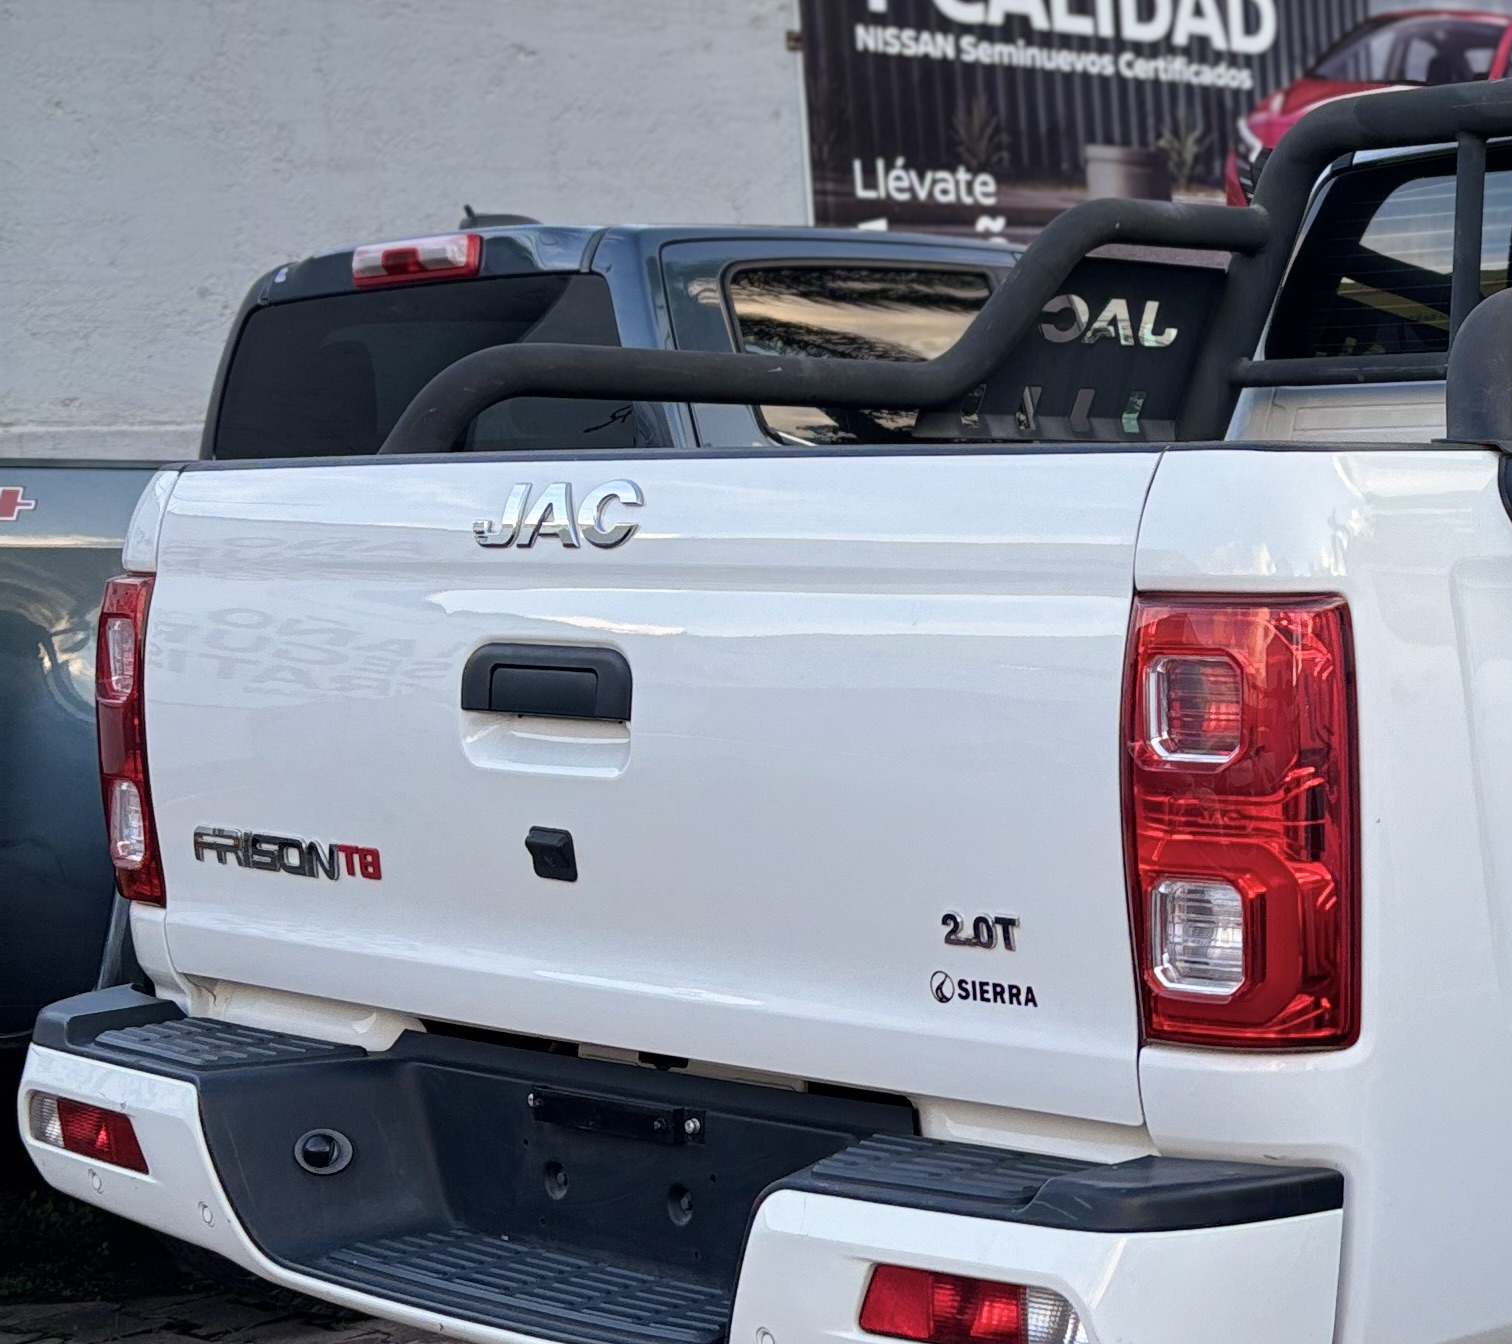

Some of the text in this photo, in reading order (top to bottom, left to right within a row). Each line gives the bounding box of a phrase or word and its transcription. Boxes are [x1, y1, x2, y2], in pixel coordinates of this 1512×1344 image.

[855, 25, 1253, 91] NISSAN Seminuevos Certificados
[853, 156, 999, 206] Llévate
[472, 478, 645, 549] JAC
[941, 910, 1021, 953] 2.0T
[957, 978, 1039, 1008] SIERRA
